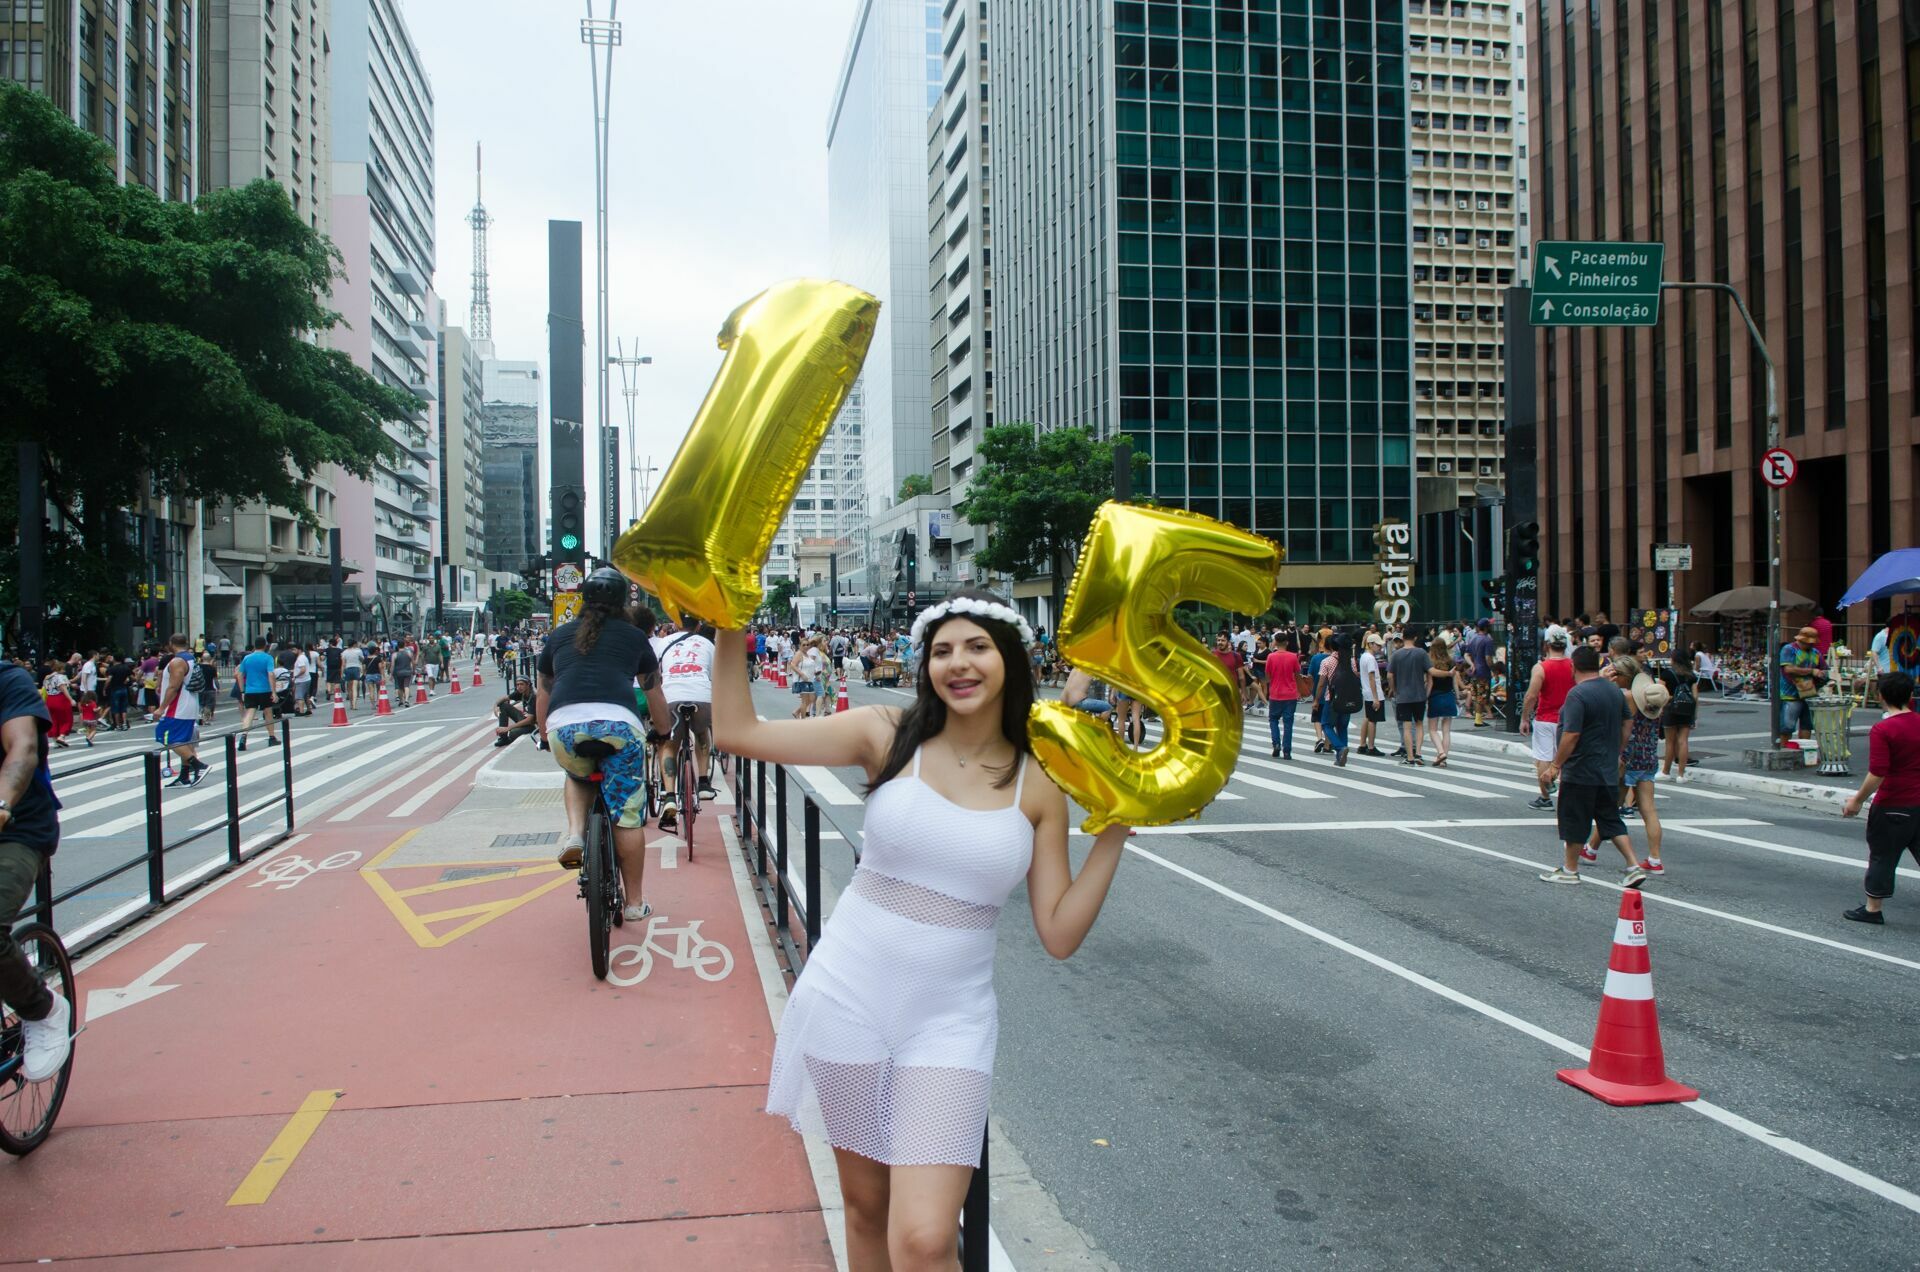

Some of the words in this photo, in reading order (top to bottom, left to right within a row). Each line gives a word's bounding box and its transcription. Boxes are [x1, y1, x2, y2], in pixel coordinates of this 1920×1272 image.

[1568, 272, 1638, 287] Pinheiros
[1571, 250, 1648, 266] Pacaembu
[1562, 303, 1649, 320] Consolação
[612, 278, 882, 631] 1
[1380, 523, 1411, 624] Safra
[1027, 499, 1285, 835] 5
